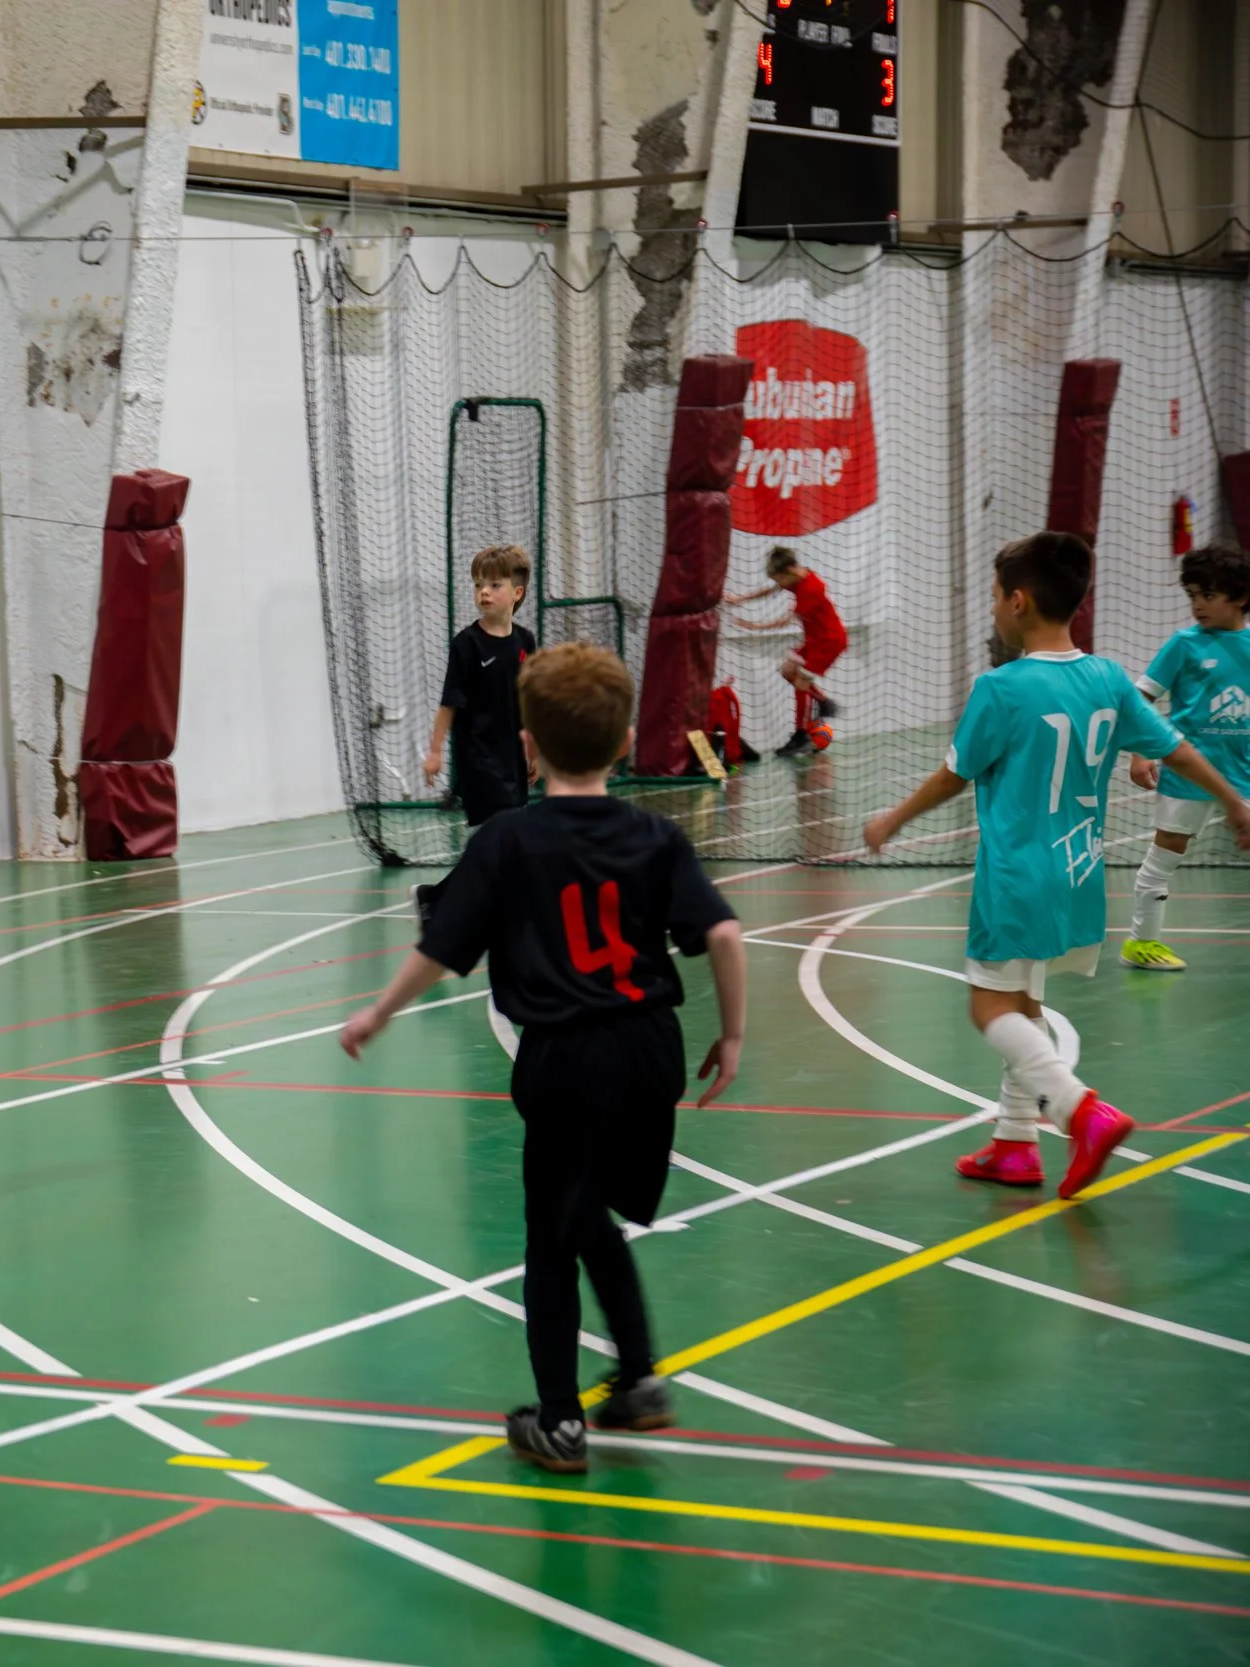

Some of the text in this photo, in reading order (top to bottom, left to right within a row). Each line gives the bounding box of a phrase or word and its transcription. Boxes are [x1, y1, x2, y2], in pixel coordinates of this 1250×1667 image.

[881, 59, 894, 106] 3
[736, 435, 842, 499] Propne
[1041, 708, 1117, 815] 19
[560, 880, 645, 1001] 4
